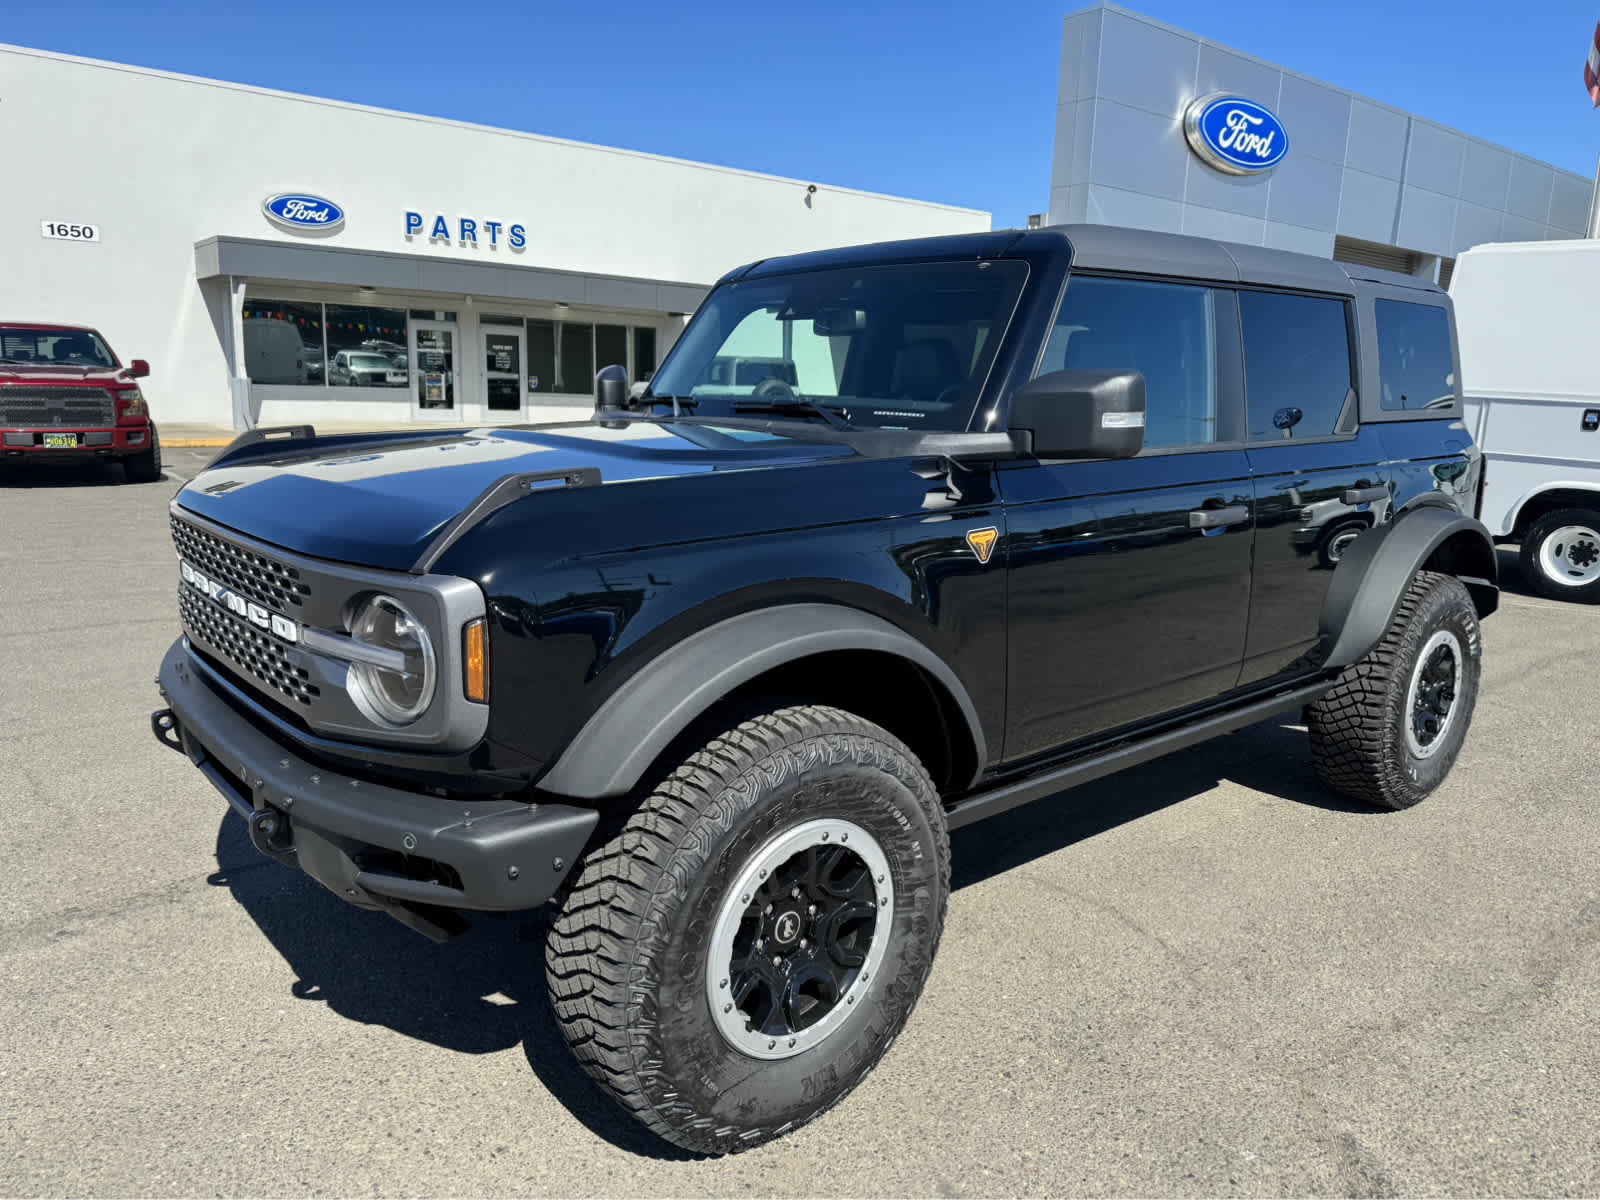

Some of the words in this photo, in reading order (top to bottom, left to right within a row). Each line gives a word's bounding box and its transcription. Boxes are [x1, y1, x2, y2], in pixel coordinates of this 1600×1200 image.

[1218, 109, 1275, 158] Ford
[282, 199, 329, 222] Ford
[46, 223, 94, 239] 1650
[405, 210, 526, 248] PARTS
